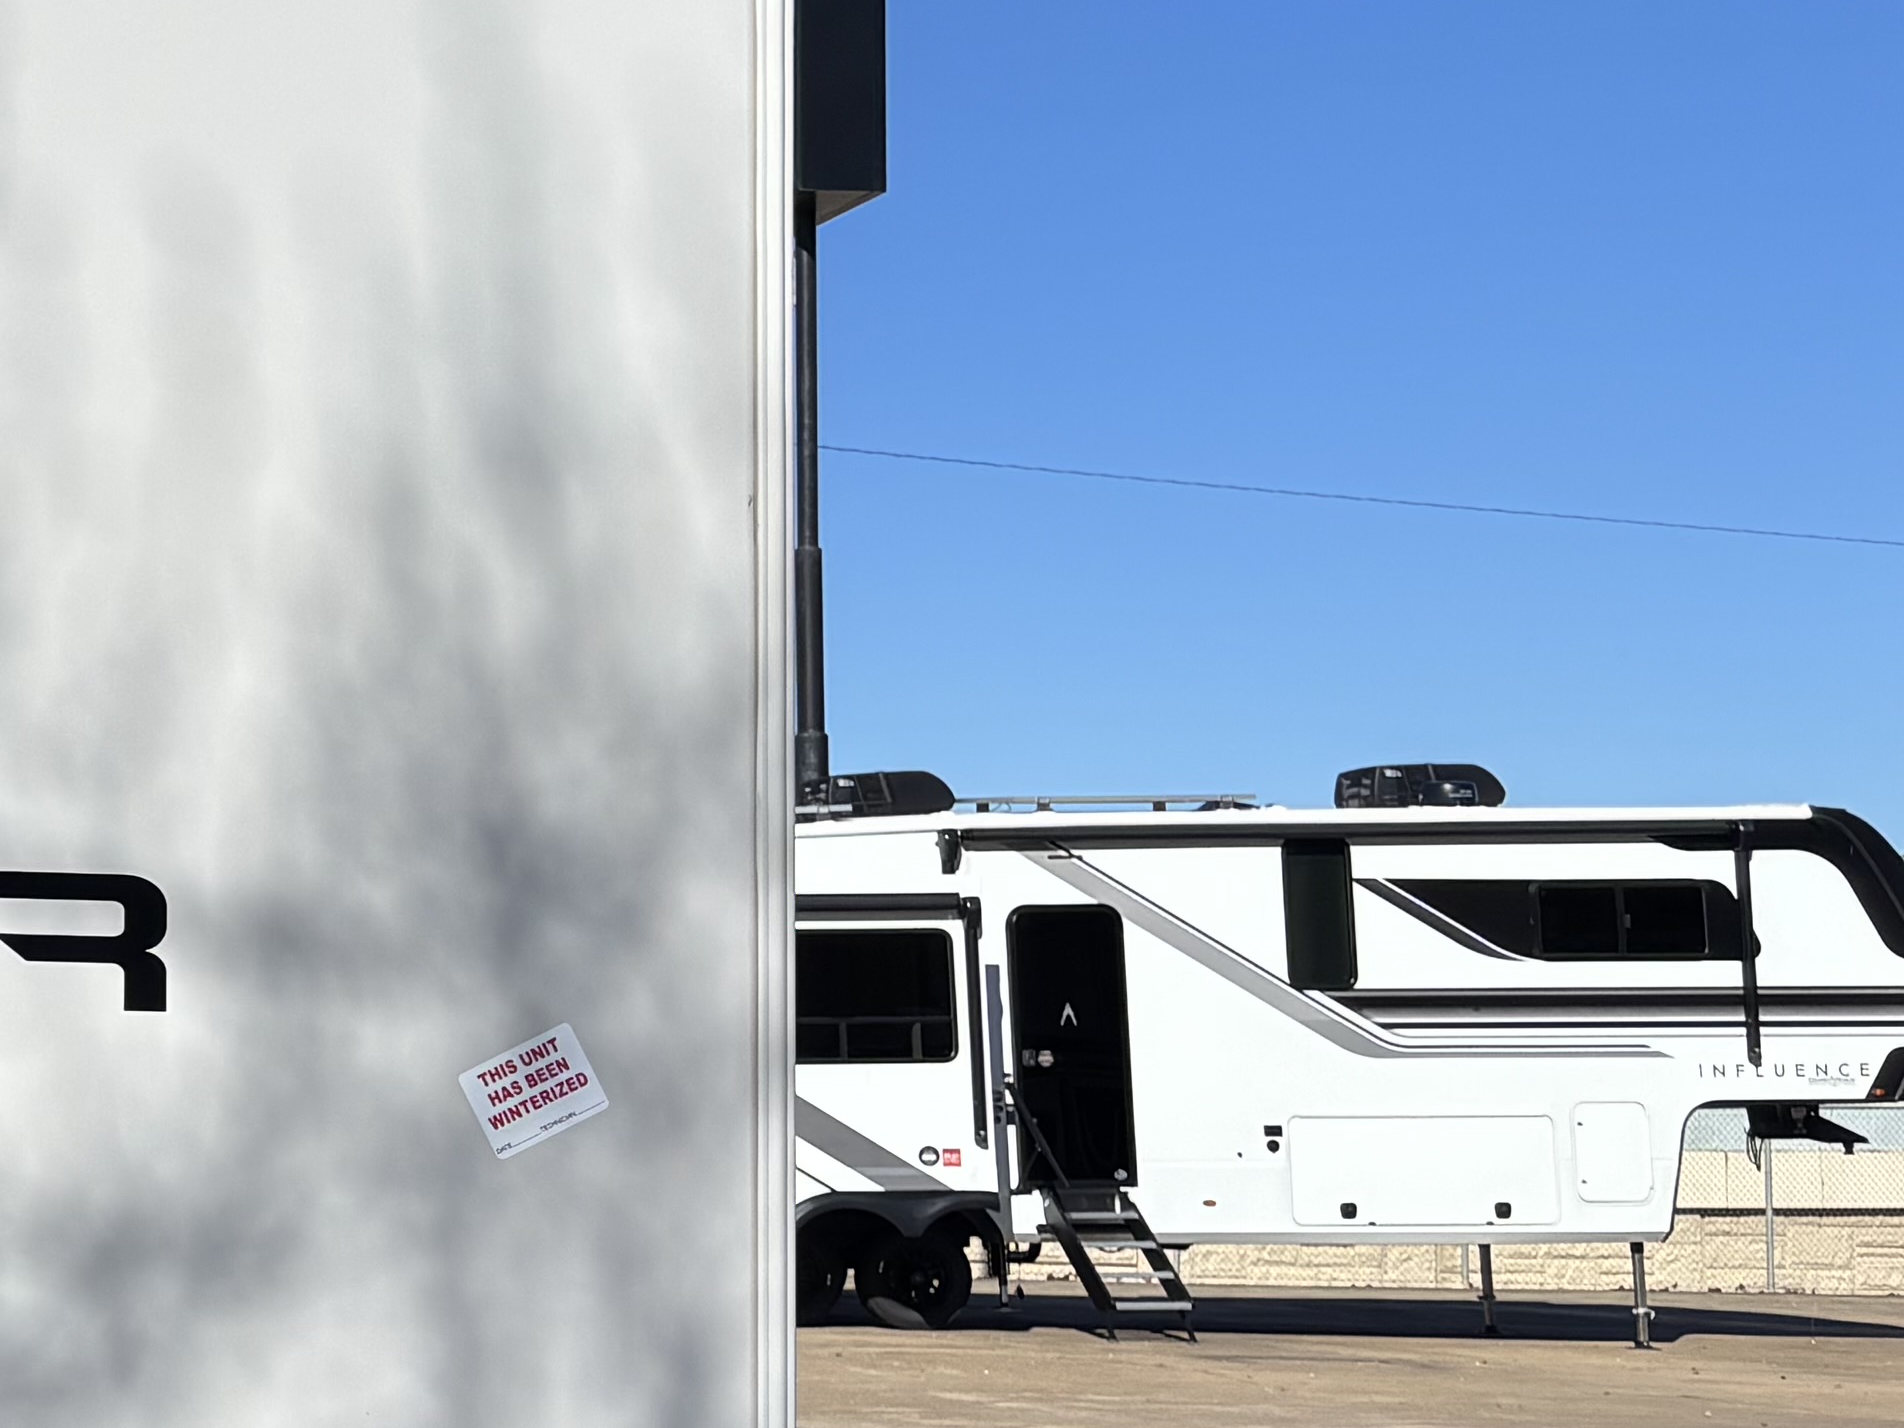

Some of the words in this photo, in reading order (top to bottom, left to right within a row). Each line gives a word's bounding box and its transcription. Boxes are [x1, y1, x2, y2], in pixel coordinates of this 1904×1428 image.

[477, 1059, 518, 1087] THIS
[518, 1037, 558, 1067] UNIT
[487, 1080, 523, 1107] HAS
[524, 1057, 570, 1089] BEEN
[1698, 1062, 1871, 1078] INFLUENCE
[488, 1072, 589, 1131] WINTERIZED
